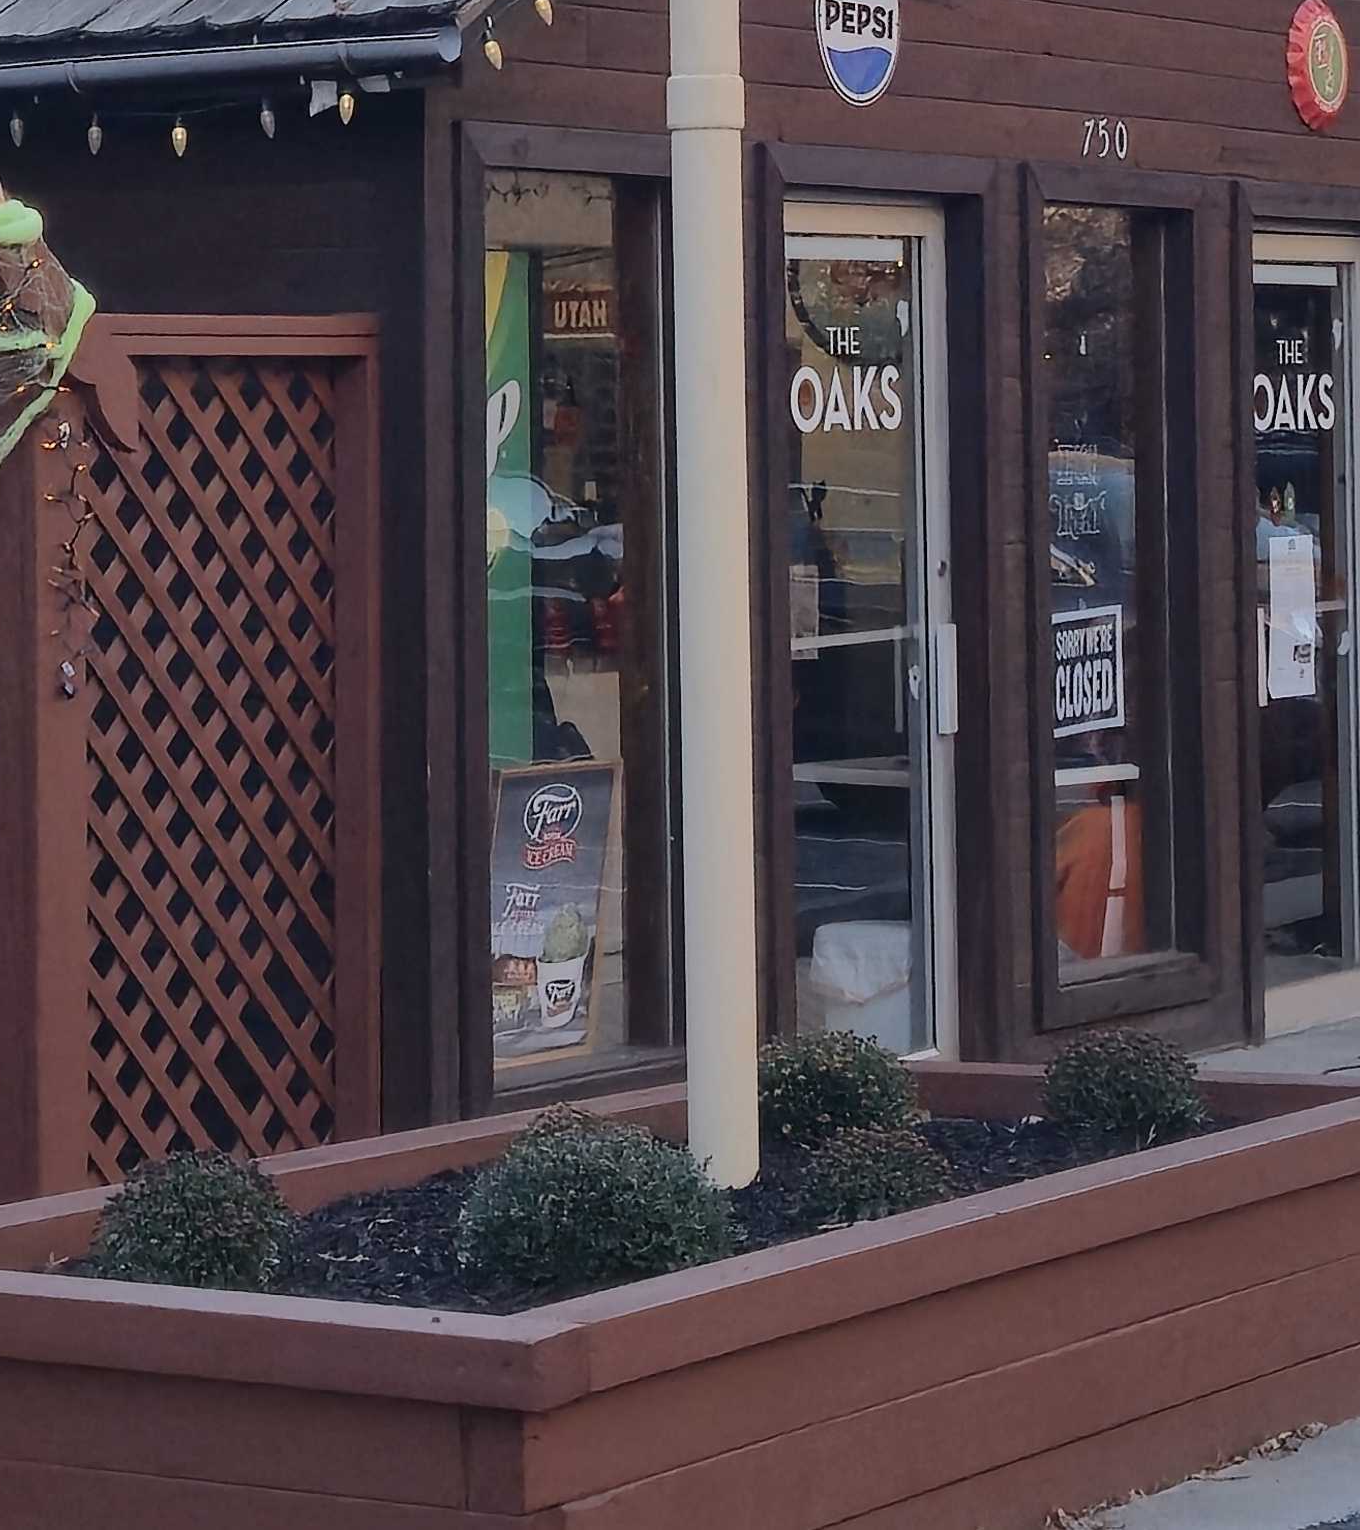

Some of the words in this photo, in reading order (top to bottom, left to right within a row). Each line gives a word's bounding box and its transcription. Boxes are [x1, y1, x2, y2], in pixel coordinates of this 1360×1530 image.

[825, 0, 894, 40] PEPSI
[1082, 117, 1128, 159] 750
[554, 299, 608, 328] UTAH
[825, 326, 861, 355] THE
[1276, 339, 1304, 365] THE
[790, 365, 902, 433] OAKS
[1253, 373, 1335, 431] OAKS
[1056, 628, 1086, 661] SORRY
[1056, 658, 1114, 722] CLOSED
